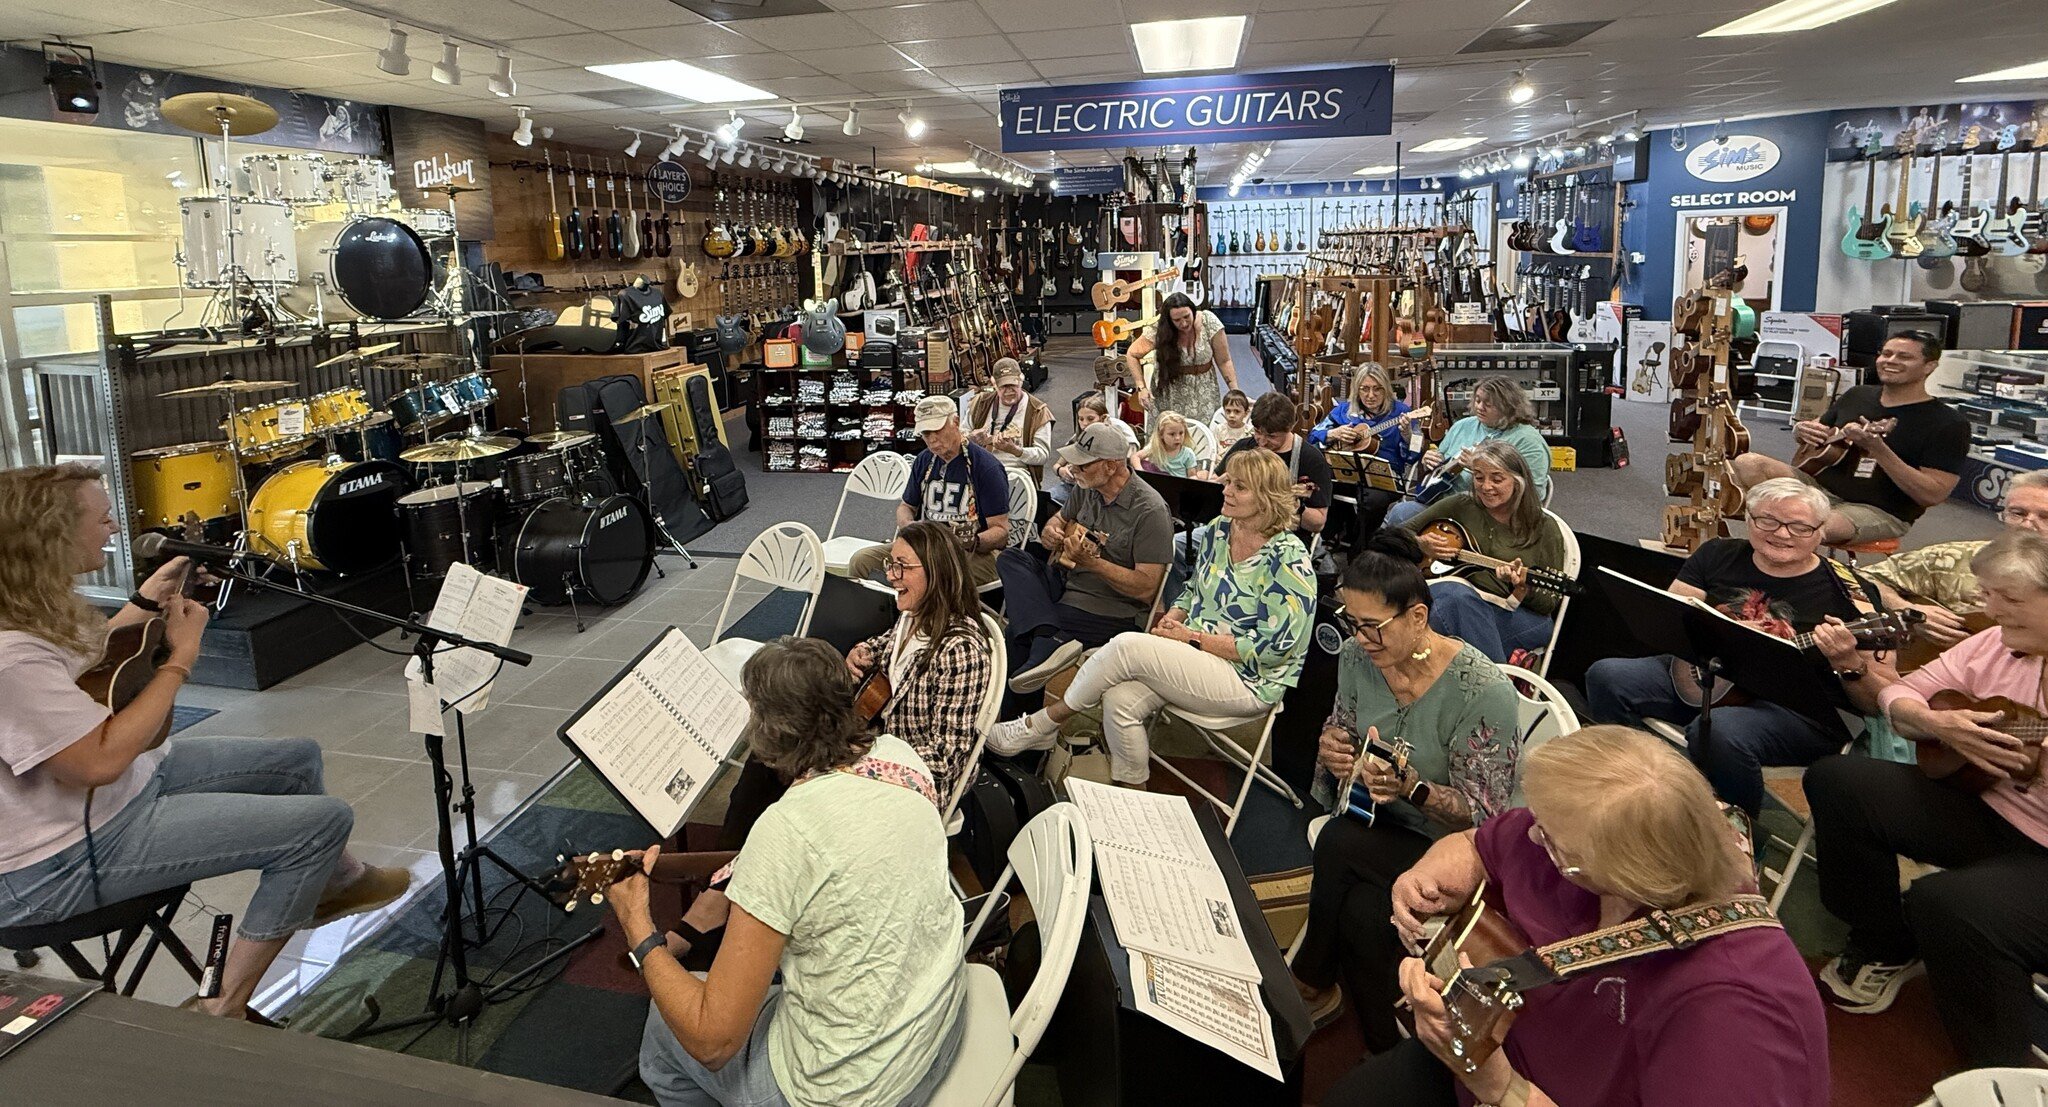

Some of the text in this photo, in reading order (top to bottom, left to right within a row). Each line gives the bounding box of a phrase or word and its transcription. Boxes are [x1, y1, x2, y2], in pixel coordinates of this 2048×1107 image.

[1015, 88, 1344, 135] ELECTRIC GUITARS
[414, 152, 476, 198] Gibson
[1736, 163, 1764, 171] MUSIC
[1671, 189, 1796, 207] SELECT ROOM
[1077, 431, 1094, 451] LA
[347, 472, 383, 493] TAMA
[605, 505, 628, 526] TAMA
